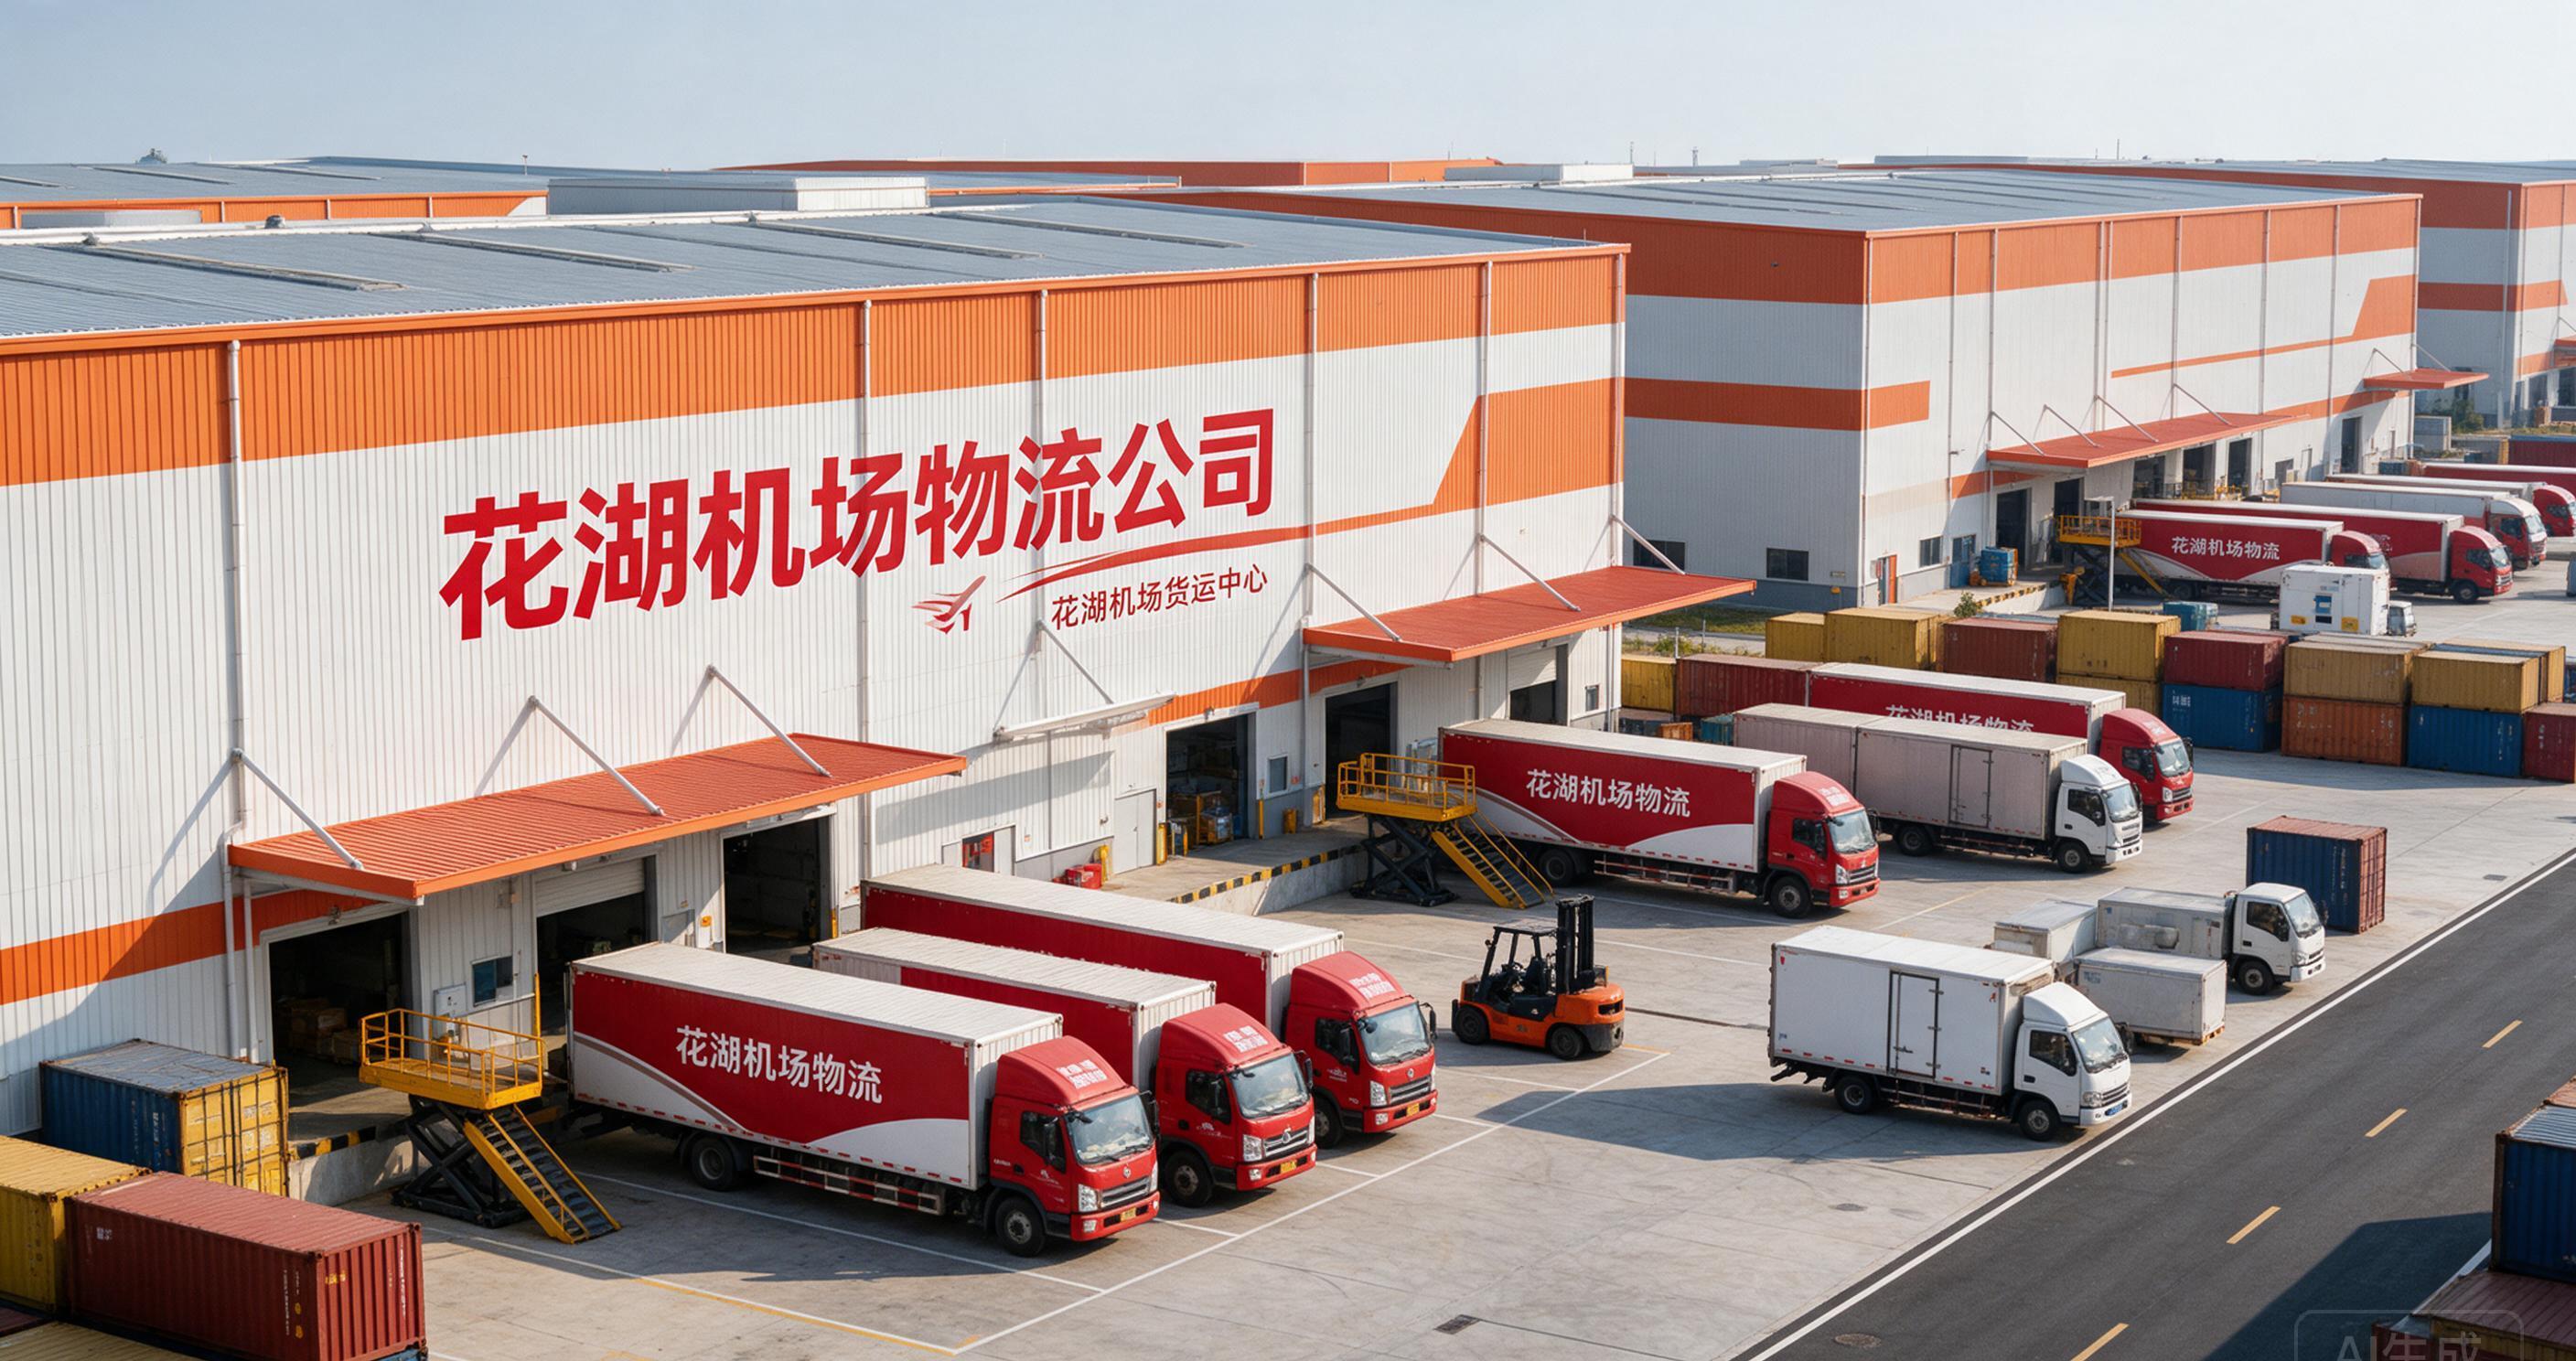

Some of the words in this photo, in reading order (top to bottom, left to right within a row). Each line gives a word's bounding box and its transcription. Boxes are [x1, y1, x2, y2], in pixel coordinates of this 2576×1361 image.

[440, 409, 1273, 640] 花湖机场物流公司
[2172, 536, 2281, 561] 花湖机场物流
[1052, 563, 1268, 630] 花湖机场货运中心
[1526, 768, 1690, 818] 花湖机场物流
[676, 1024, 883, 1104] 花湖机场物流
